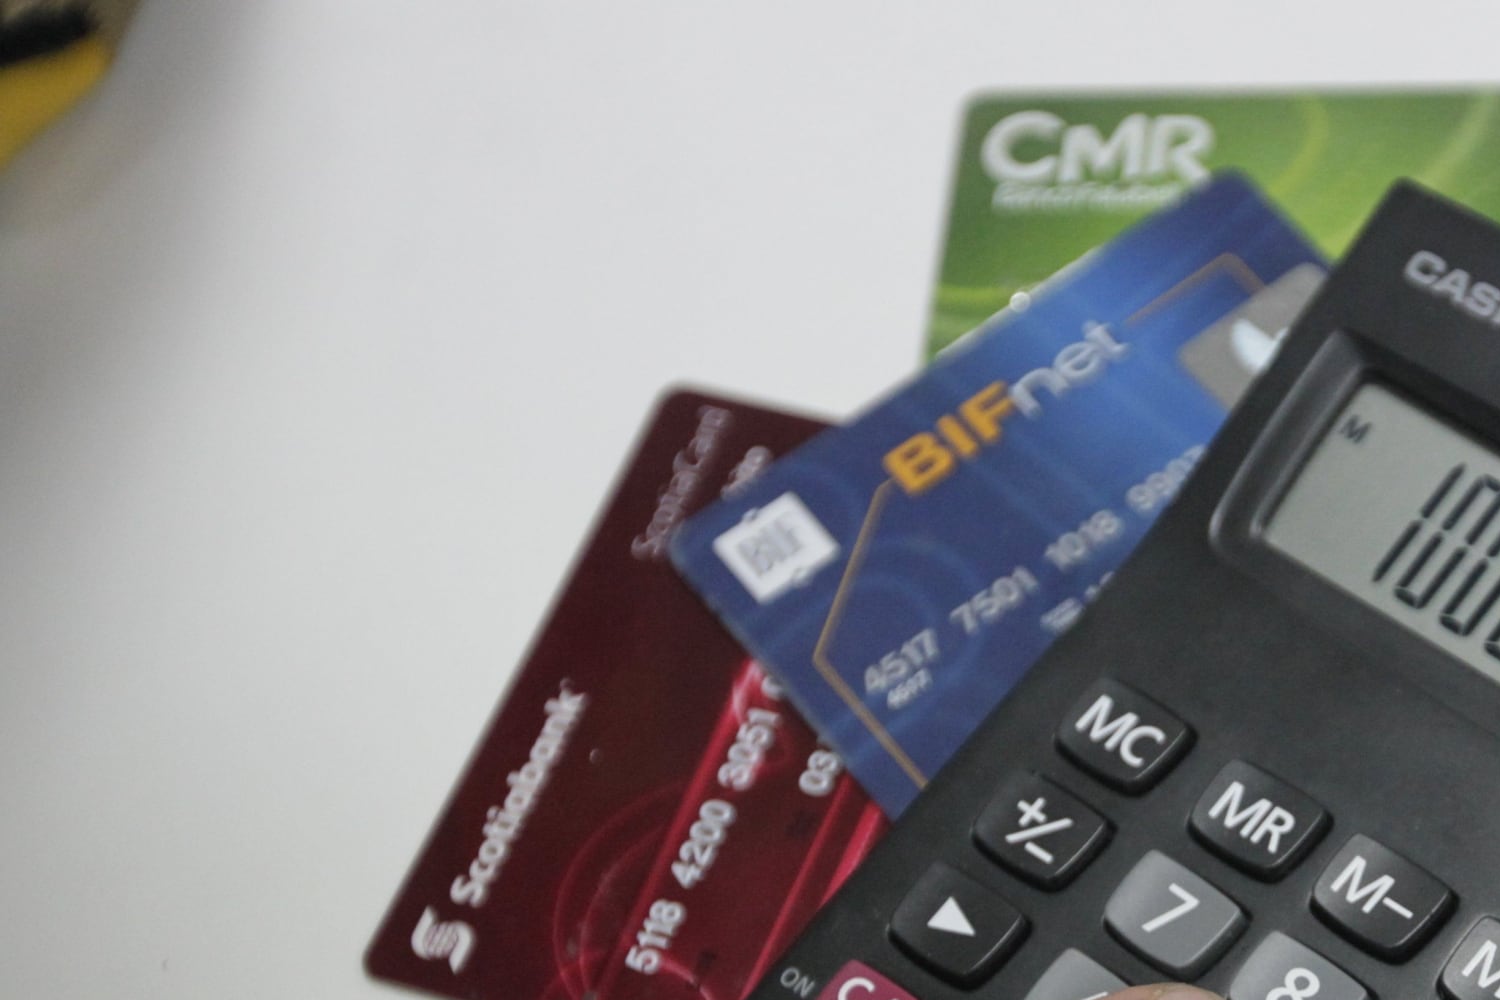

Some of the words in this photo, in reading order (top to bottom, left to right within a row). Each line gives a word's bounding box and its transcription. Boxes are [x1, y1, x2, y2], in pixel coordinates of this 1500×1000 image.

[981, 109, 1213, 186] CMR
[1340, 414, 1372, 444] M
[950, 565, 1038, 633] 7501
[1075, 695, 1167, 767] MC
[451, 688, 586, 907] Scotiabank
[1207, 781, 1296, 854] MR
[671, 799, 736, 888] 4200
[1142, 883, 1199, 933] 7
[779, 966, 816, 999] ON
